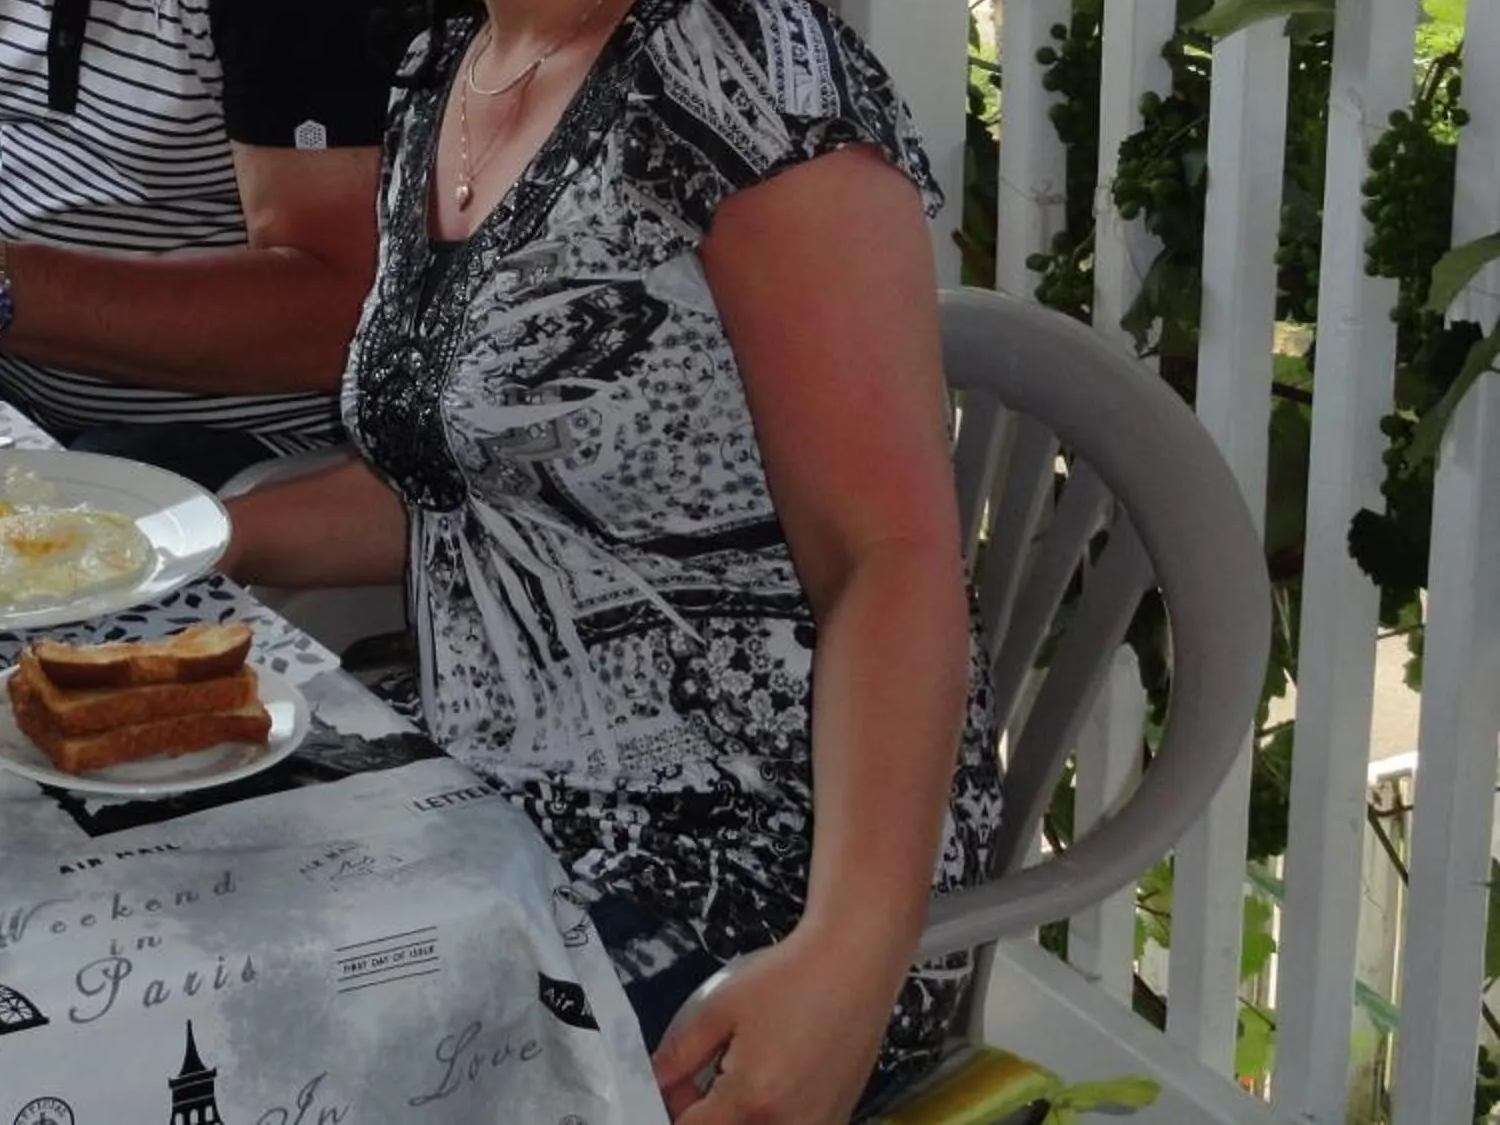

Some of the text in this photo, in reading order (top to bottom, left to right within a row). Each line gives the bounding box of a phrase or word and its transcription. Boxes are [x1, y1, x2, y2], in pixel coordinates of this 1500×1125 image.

[58, 842, 183, 875] AIR MAIL
[109, 933, 163, 958] in
[343, 944, 436, 974] FIRST DAY OF ISSUE
[68, 953, 259, 1025] Paris
[408, 1021, 544, 1108] Love
